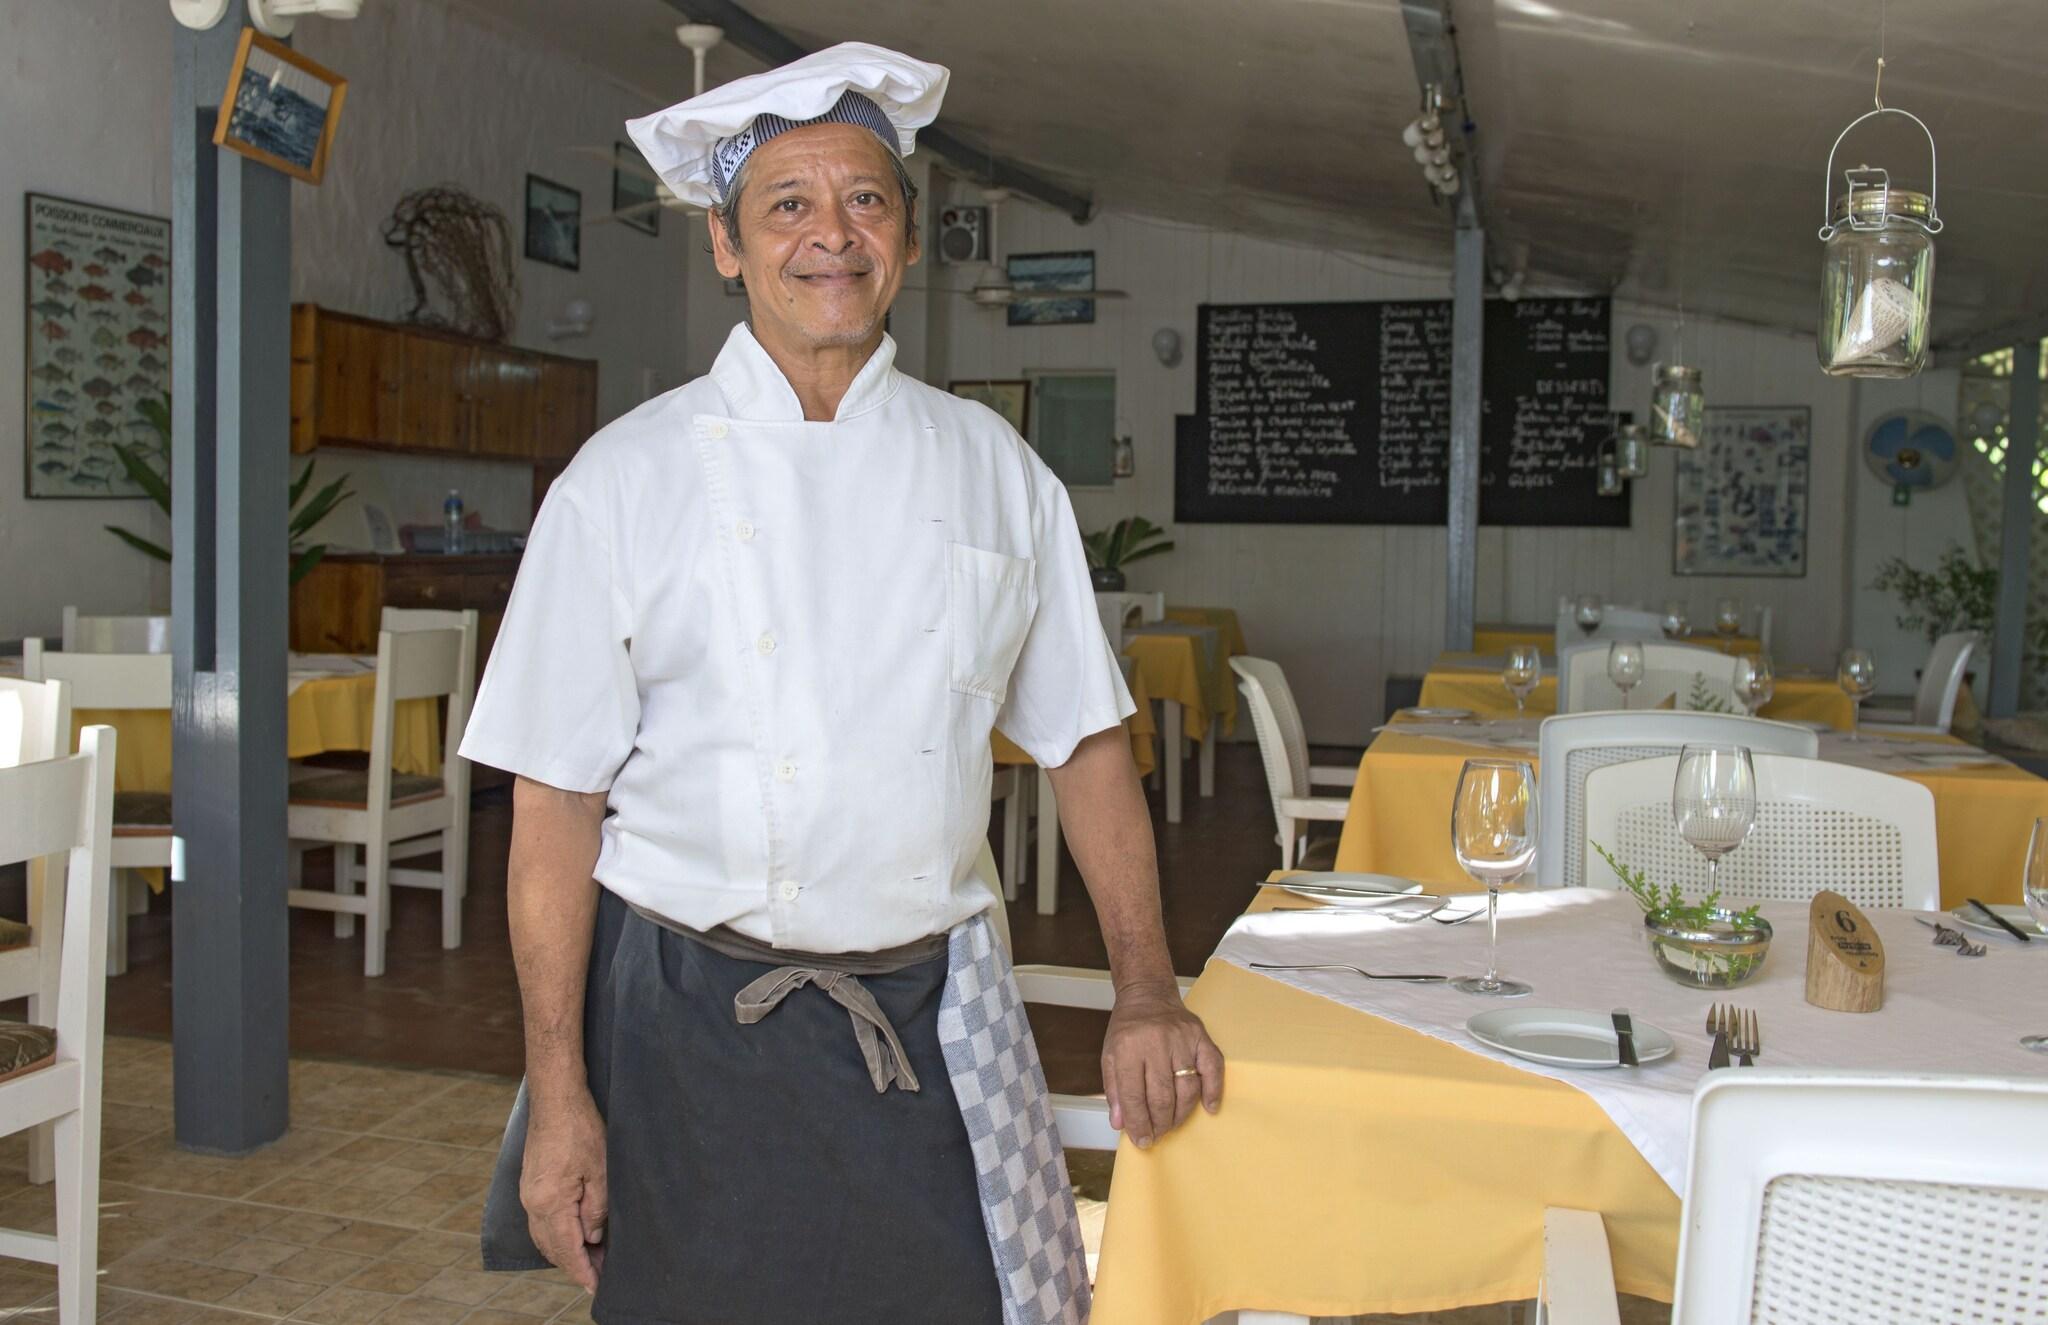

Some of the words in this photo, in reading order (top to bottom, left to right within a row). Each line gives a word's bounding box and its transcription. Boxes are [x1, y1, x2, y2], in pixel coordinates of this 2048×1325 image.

[35, 203, 89, 226] POISSONS
[92, 213, 164, 239] COMMERCIAUX
[1836, 910, 1856, 933] 6
